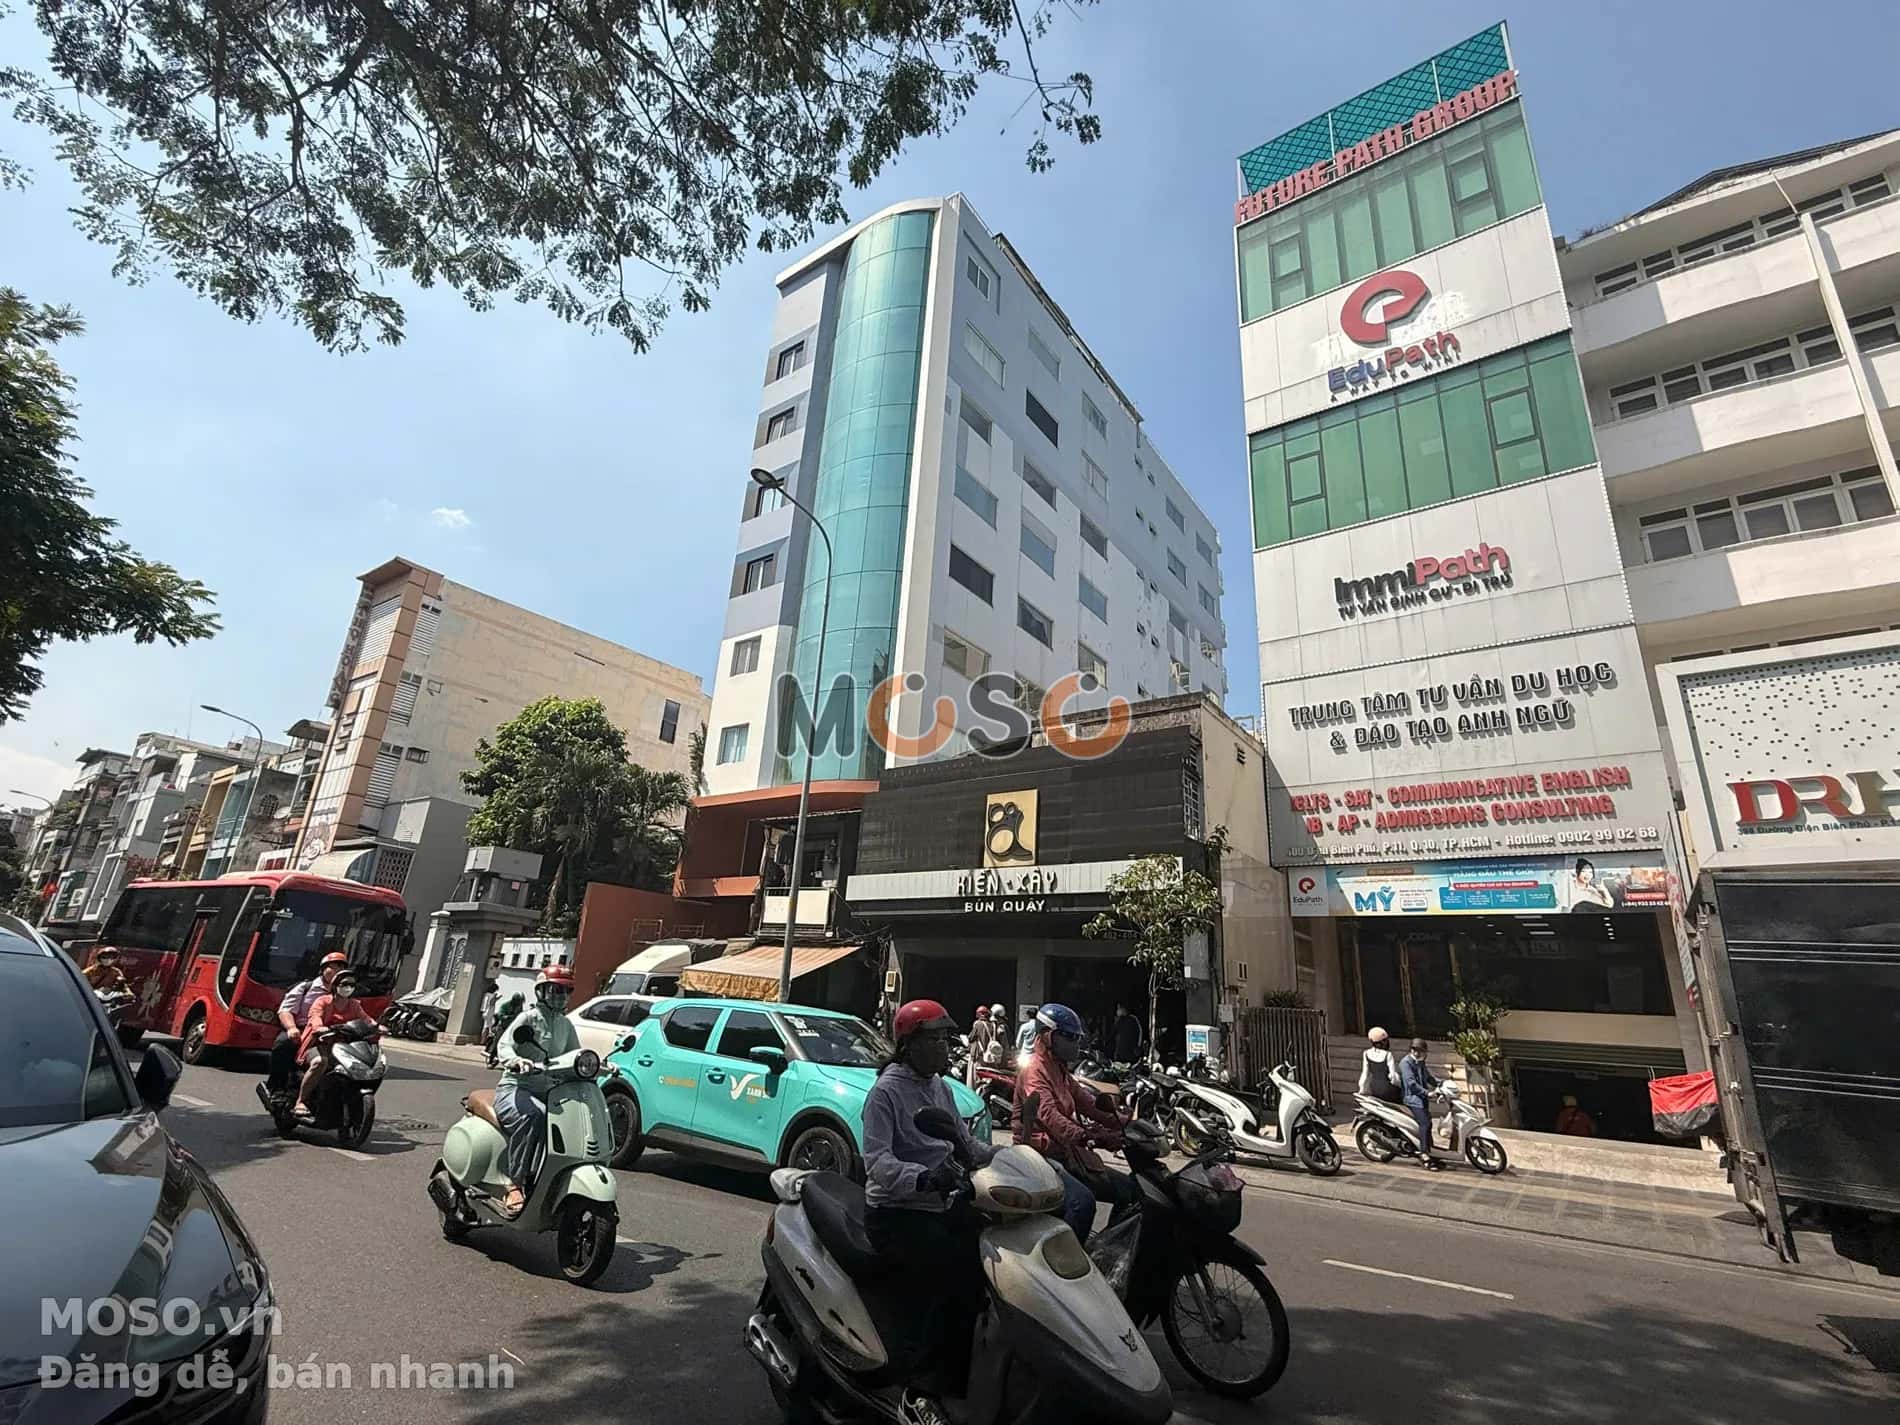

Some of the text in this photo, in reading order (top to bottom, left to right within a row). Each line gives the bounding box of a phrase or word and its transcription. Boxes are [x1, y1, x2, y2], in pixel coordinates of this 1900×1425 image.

[1234, 70, 1515, 224] FUTURE PATH GROUP
[1327, 331, 1459, 393] EduPath
[1334, 542, 1510, 604] ImmiPath
[1288, 700, 1353, 724] TRUNG
[1361, 691, 1408, 714] TÂM
[1416, 684, 1444, 706] TƯ
[1511, 671, 1546, 693] DU
[1556, 662, 1613, 689] HỌC
[1330, 730, 1346, 748] &
[1406, 717, 1449, 743] TẠO
[1458, 709, 1507, 733] ANH
[1344, 789, 1374, 807] SAT
[1387, 774, 1537, 805] COMMUNICATIVE
[1540, 766, 1631, 792] ENGLISH
[1338, 814, 1359, 833] AP
[1375, 804, 1487, 830] ADMISSIONS
[1491, 795, 1615, 822] CONSULTING
[1506, 831, 1554, 846] Hotline:
[1557, 831, 1592, 844] 0902
[1596, 829, 1613, 841] 99
[1616, 827, 1635, 840] 02
[1639, 826, 1657, 838] 68
[965, 898, 995, 913] BÚN
[1354, 886, 1396, 912] MỸ
